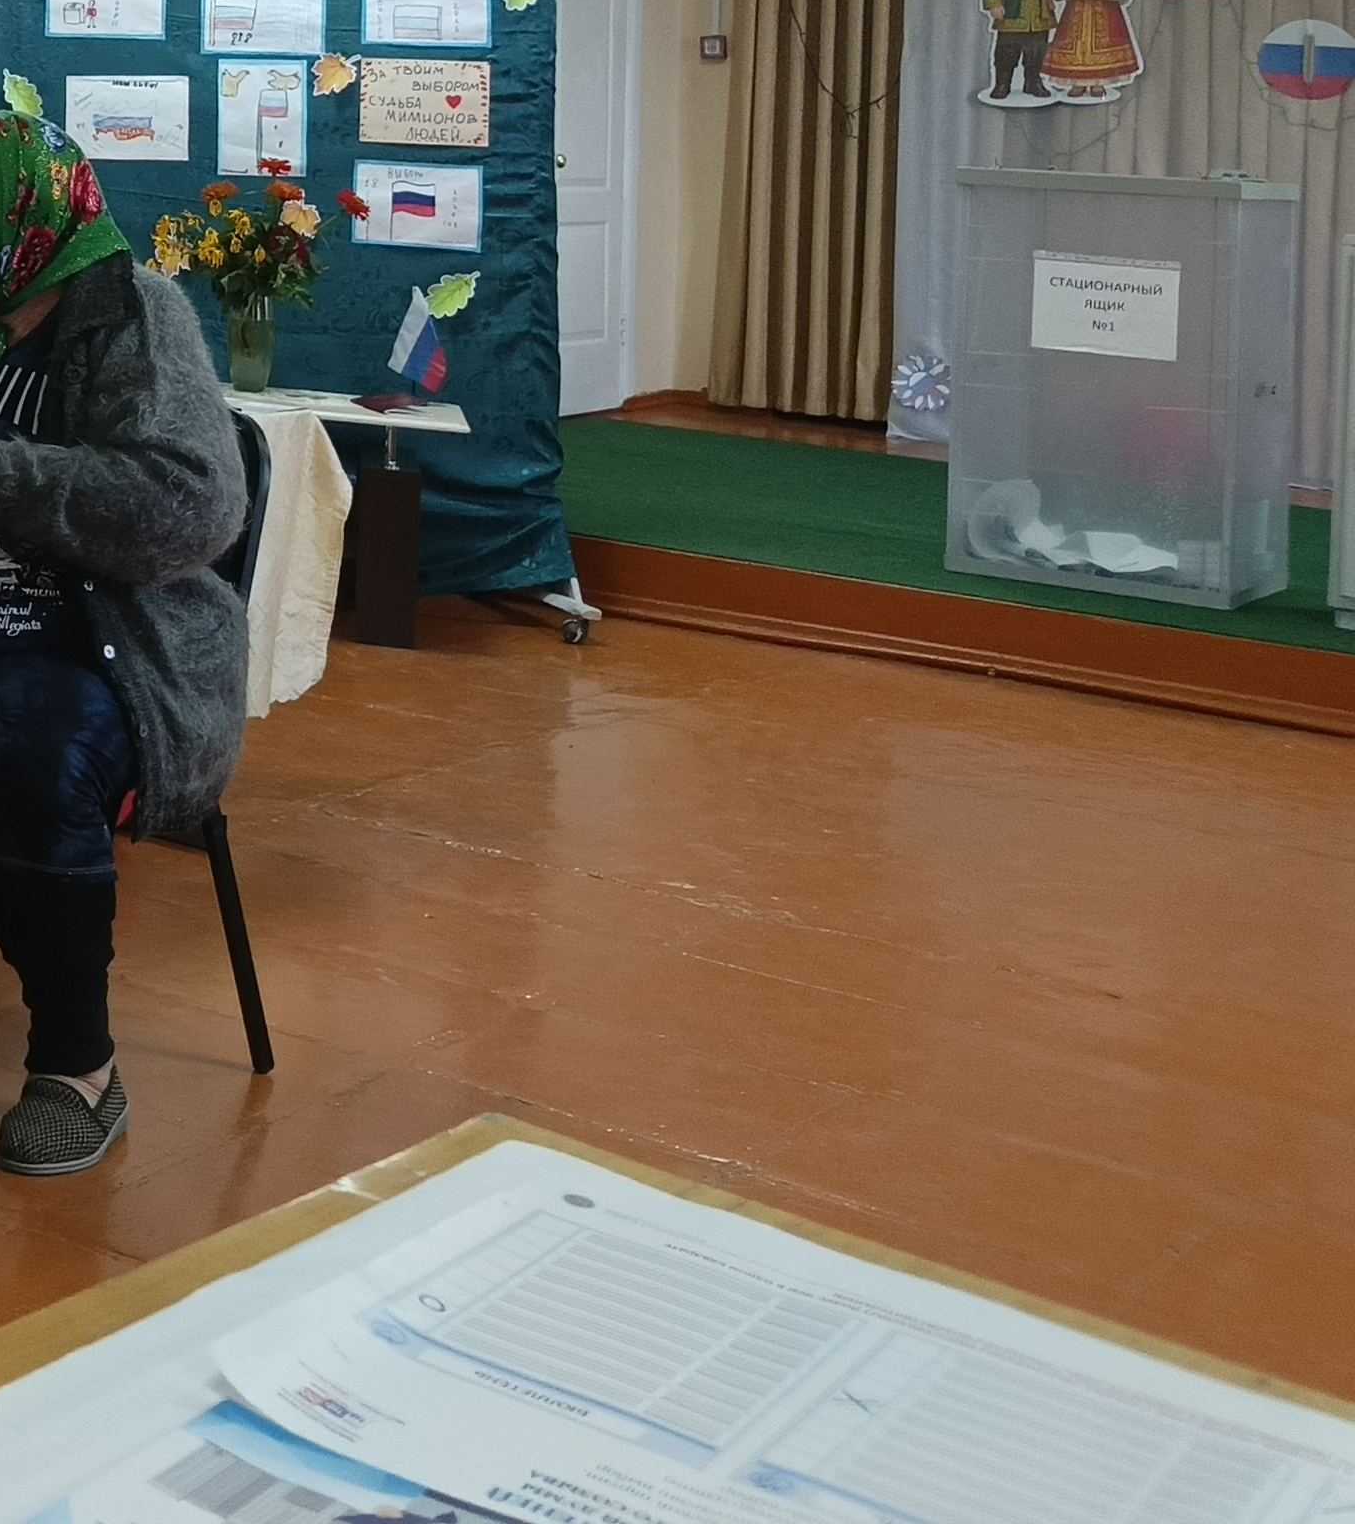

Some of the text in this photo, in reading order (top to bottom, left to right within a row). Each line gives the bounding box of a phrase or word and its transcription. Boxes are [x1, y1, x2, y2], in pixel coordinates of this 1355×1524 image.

[367, 64, 444, 82] ЗА ТВОИМ
[412, 81, 480, 92] ВЫБОРОМ
[369, 95, 422, 110] СУДЬБА
[1049, 276, 1164, 296] СТАЦИОНАРНЫЙ
[1084, 298, 1126, 312] ЯЩИК
[1092, 319, 1115, 332] №1
